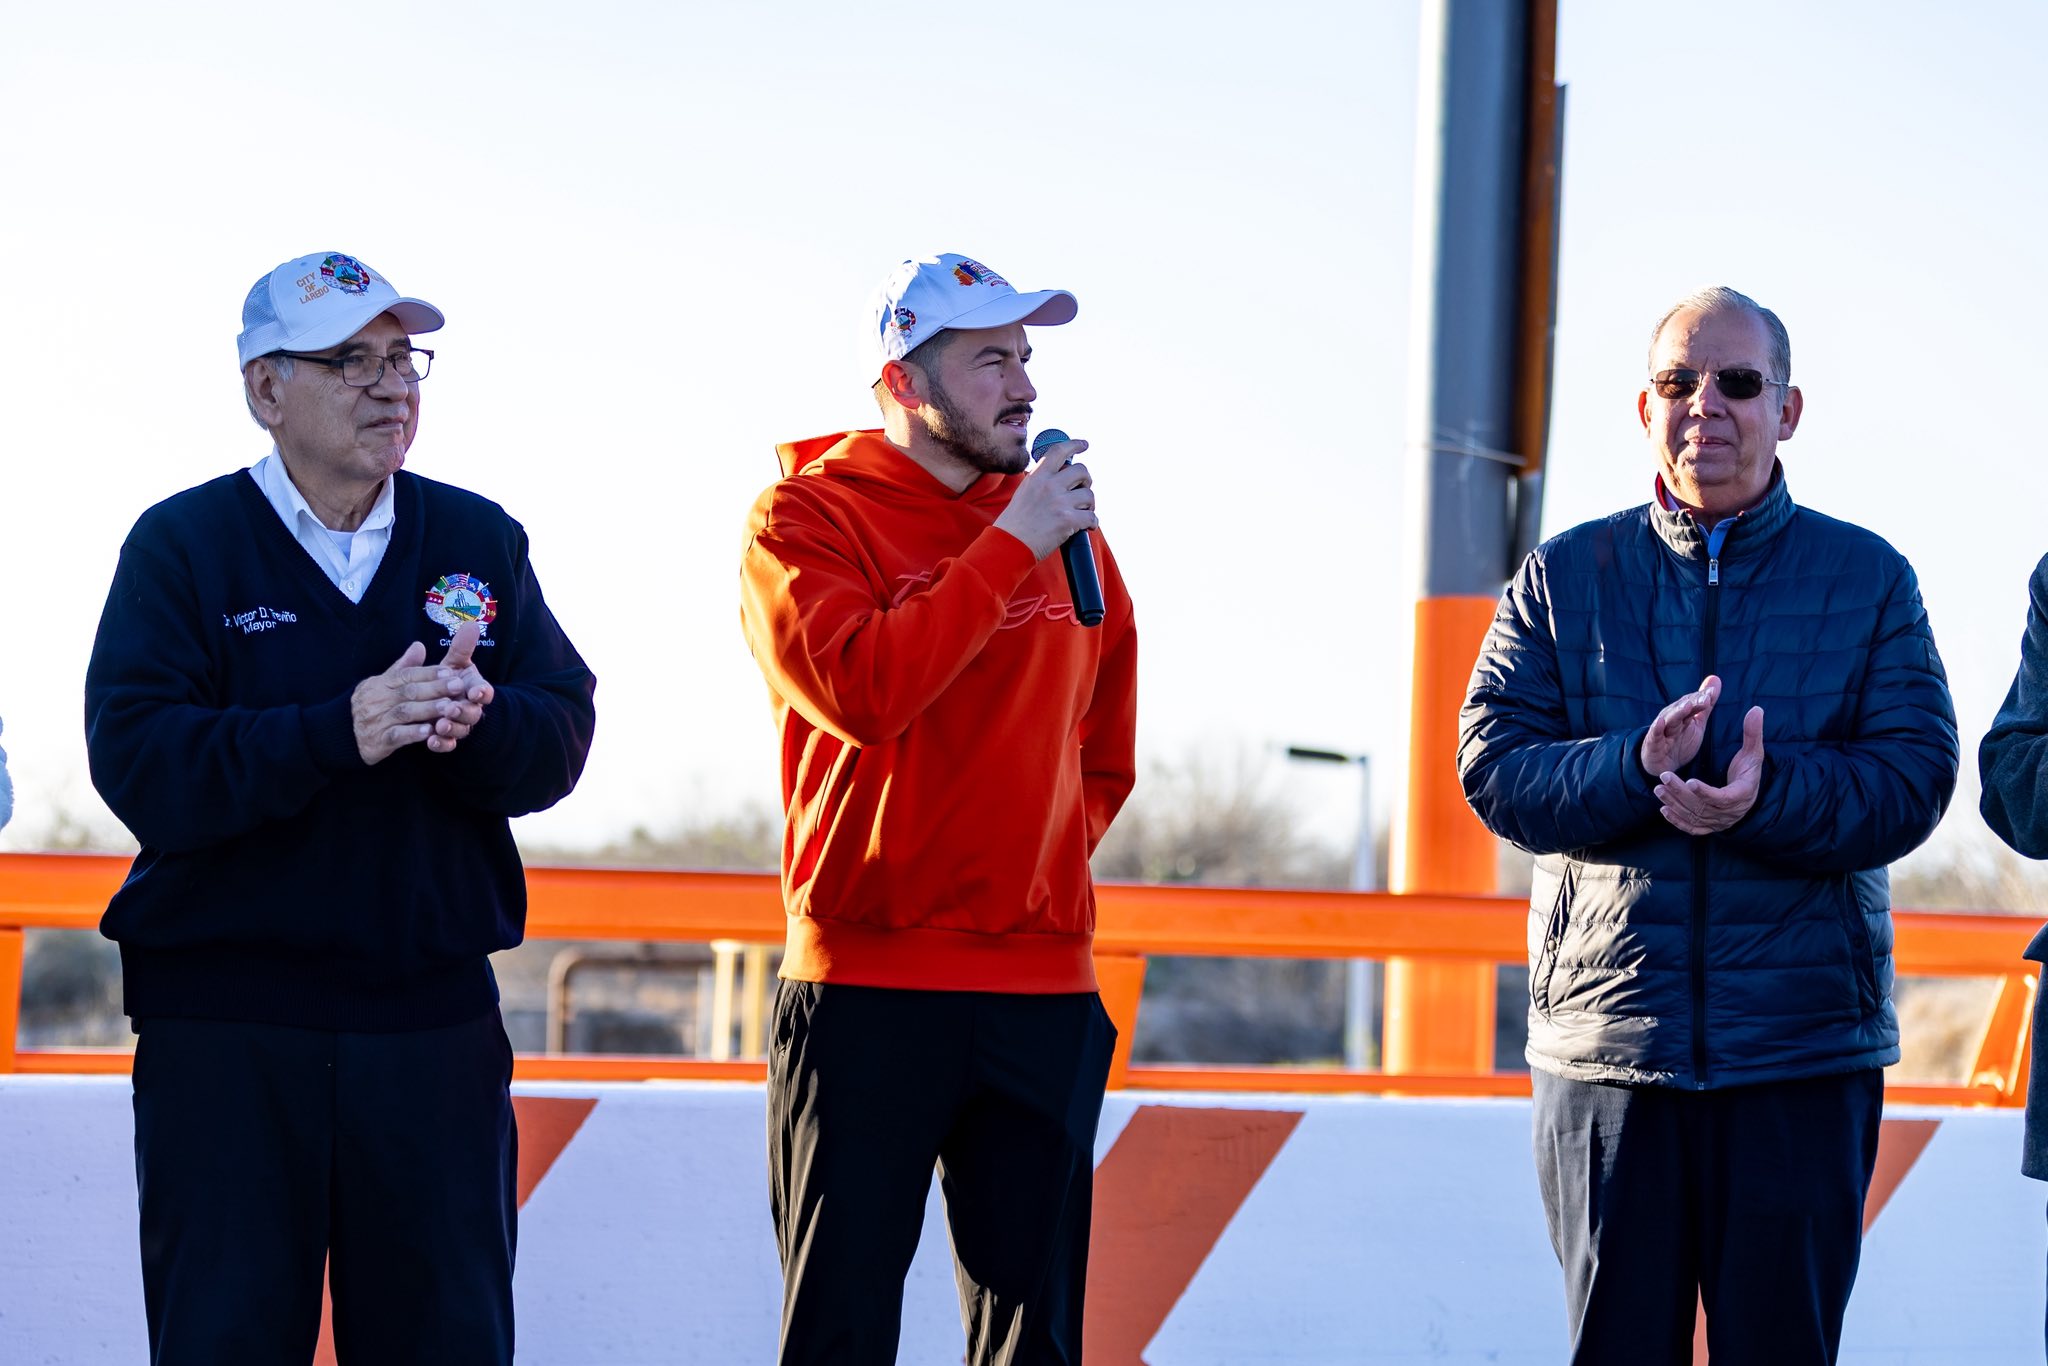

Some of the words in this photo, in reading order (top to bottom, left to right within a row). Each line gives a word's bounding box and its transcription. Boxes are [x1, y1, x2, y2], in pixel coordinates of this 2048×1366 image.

[296, 272, 317, 288] CITY
[304, 283, 317, 293] OF
[299, 285, 330, 304] LAREDO
[233, 610, 257, 627] Victor
[259, 606, 269, 618] D.
[243, 620, 276, 634] Mayor
